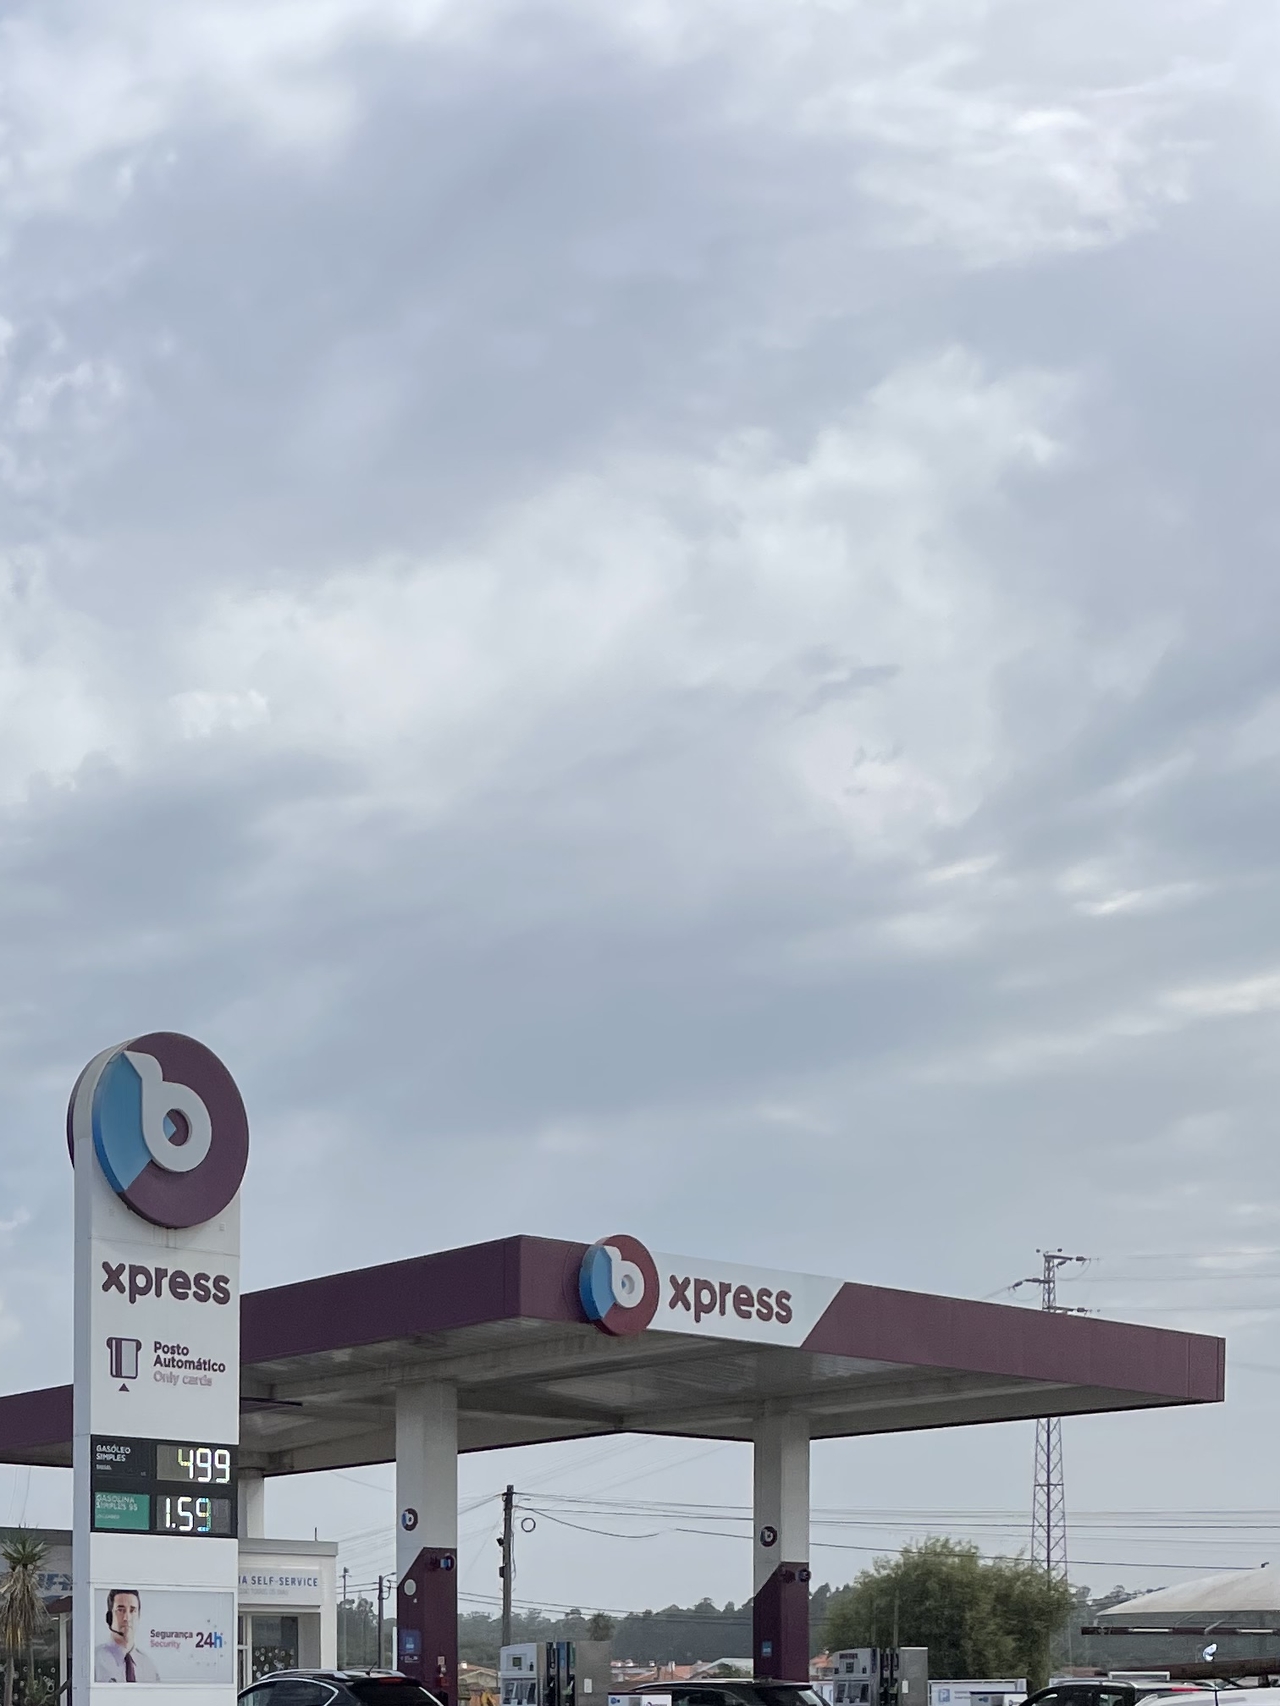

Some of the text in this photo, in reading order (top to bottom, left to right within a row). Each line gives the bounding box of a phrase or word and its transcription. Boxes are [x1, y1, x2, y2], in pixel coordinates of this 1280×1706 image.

[101, 1261, 231, 1305] xpress
[669, 1274, 793, 1324] xpress
[153, 1341, 190, 1356] Posto
[153, 1355, 226, 1373] Automático
[153, 1371, 180, 1386] Only
[96, 1444, 132, 1454] GASÓLEO
[96, 1453, 126, 1462] SIMPLES
[96, 1494, 135, 1504] GASOLINA
[96, 1502, 127, 1511] SIMPLES
[150, 1629, 223, 1649] Segurança 24h
[150, 1639, 181, 1649] Security
